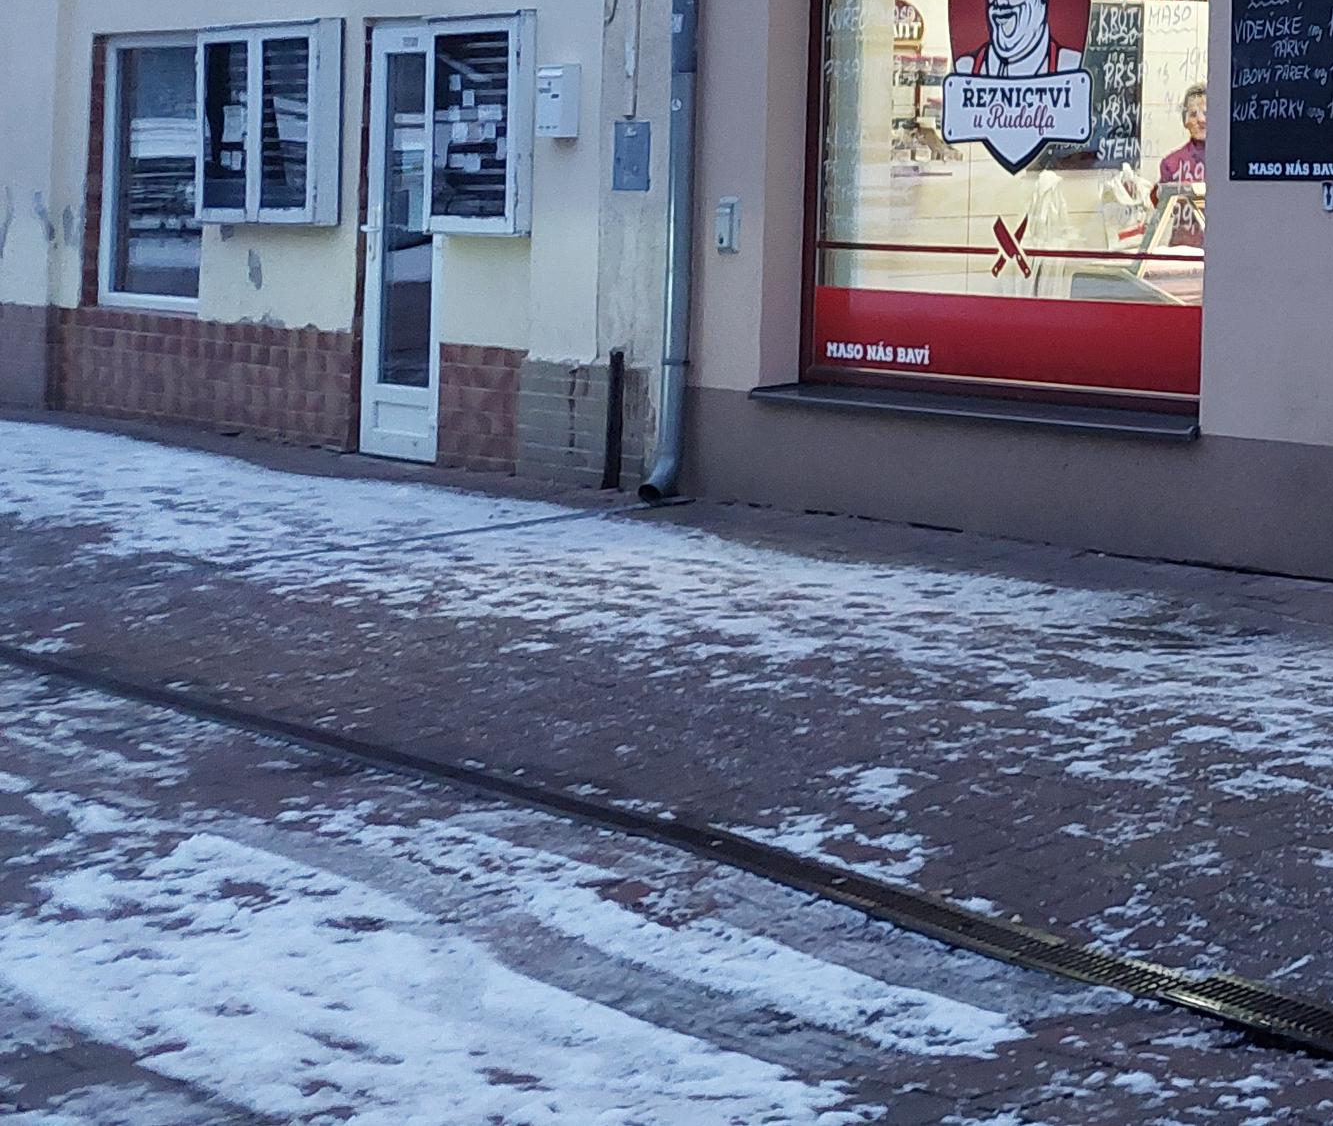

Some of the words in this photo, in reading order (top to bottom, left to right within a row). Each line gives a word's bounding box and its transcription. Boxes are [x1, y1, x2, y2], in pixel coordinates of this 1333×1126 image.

[962, 80, 1071, 108] ŘEZNICTVÍ
[973, 114, 983, 128] u
[987, 103, 1055, 136] Rudolfa
[1248, 162, 1282, 176] MASO
[1285, 159, 1310, 176] NÁS
[826, 341, 863, 359] MASO
[866, 341, 893, 361] NÁS
[896, 344, 930, 365] BAVÍ
